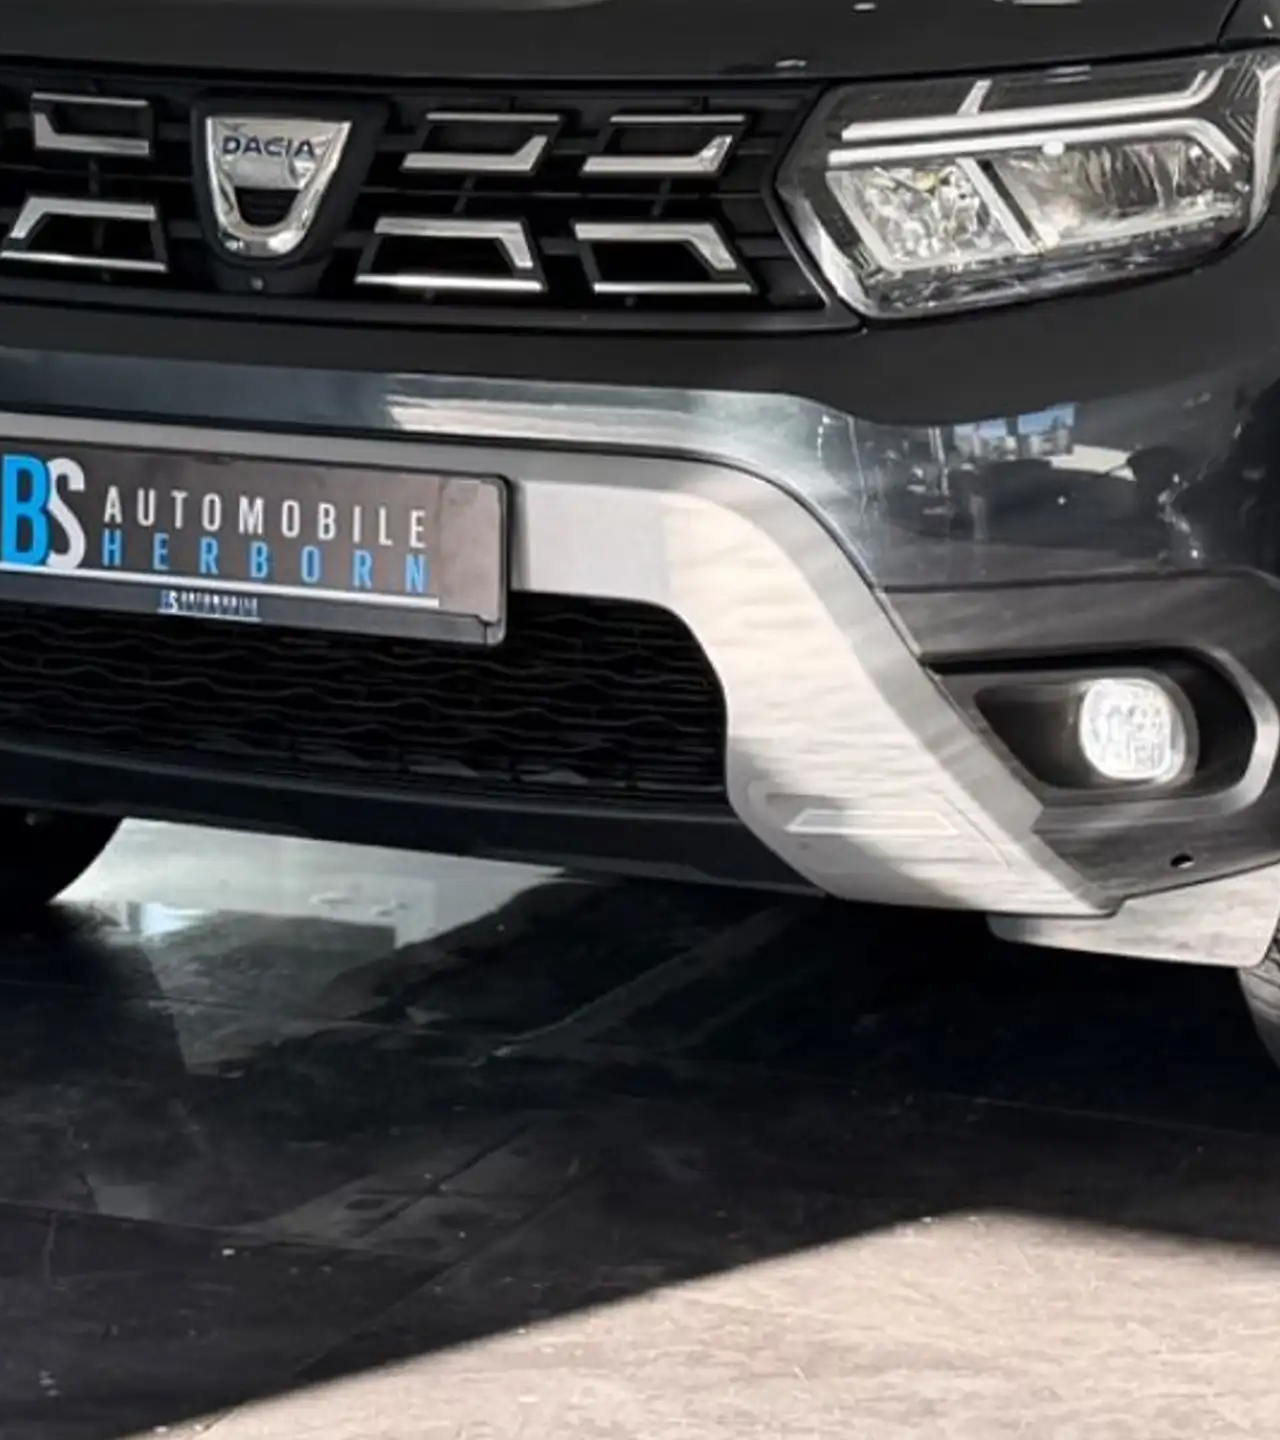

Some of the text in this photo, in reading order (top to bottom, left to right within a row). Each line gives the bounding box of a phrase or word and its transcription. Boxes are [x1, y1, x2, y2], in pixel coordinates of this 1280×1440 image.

[223, 134, 315, 158] DACIA
[0, 453, 86, 570] BS
[103, 485, 427, 549] AUTOMOBILE
[102, 528, 429, 594] HERBORN
